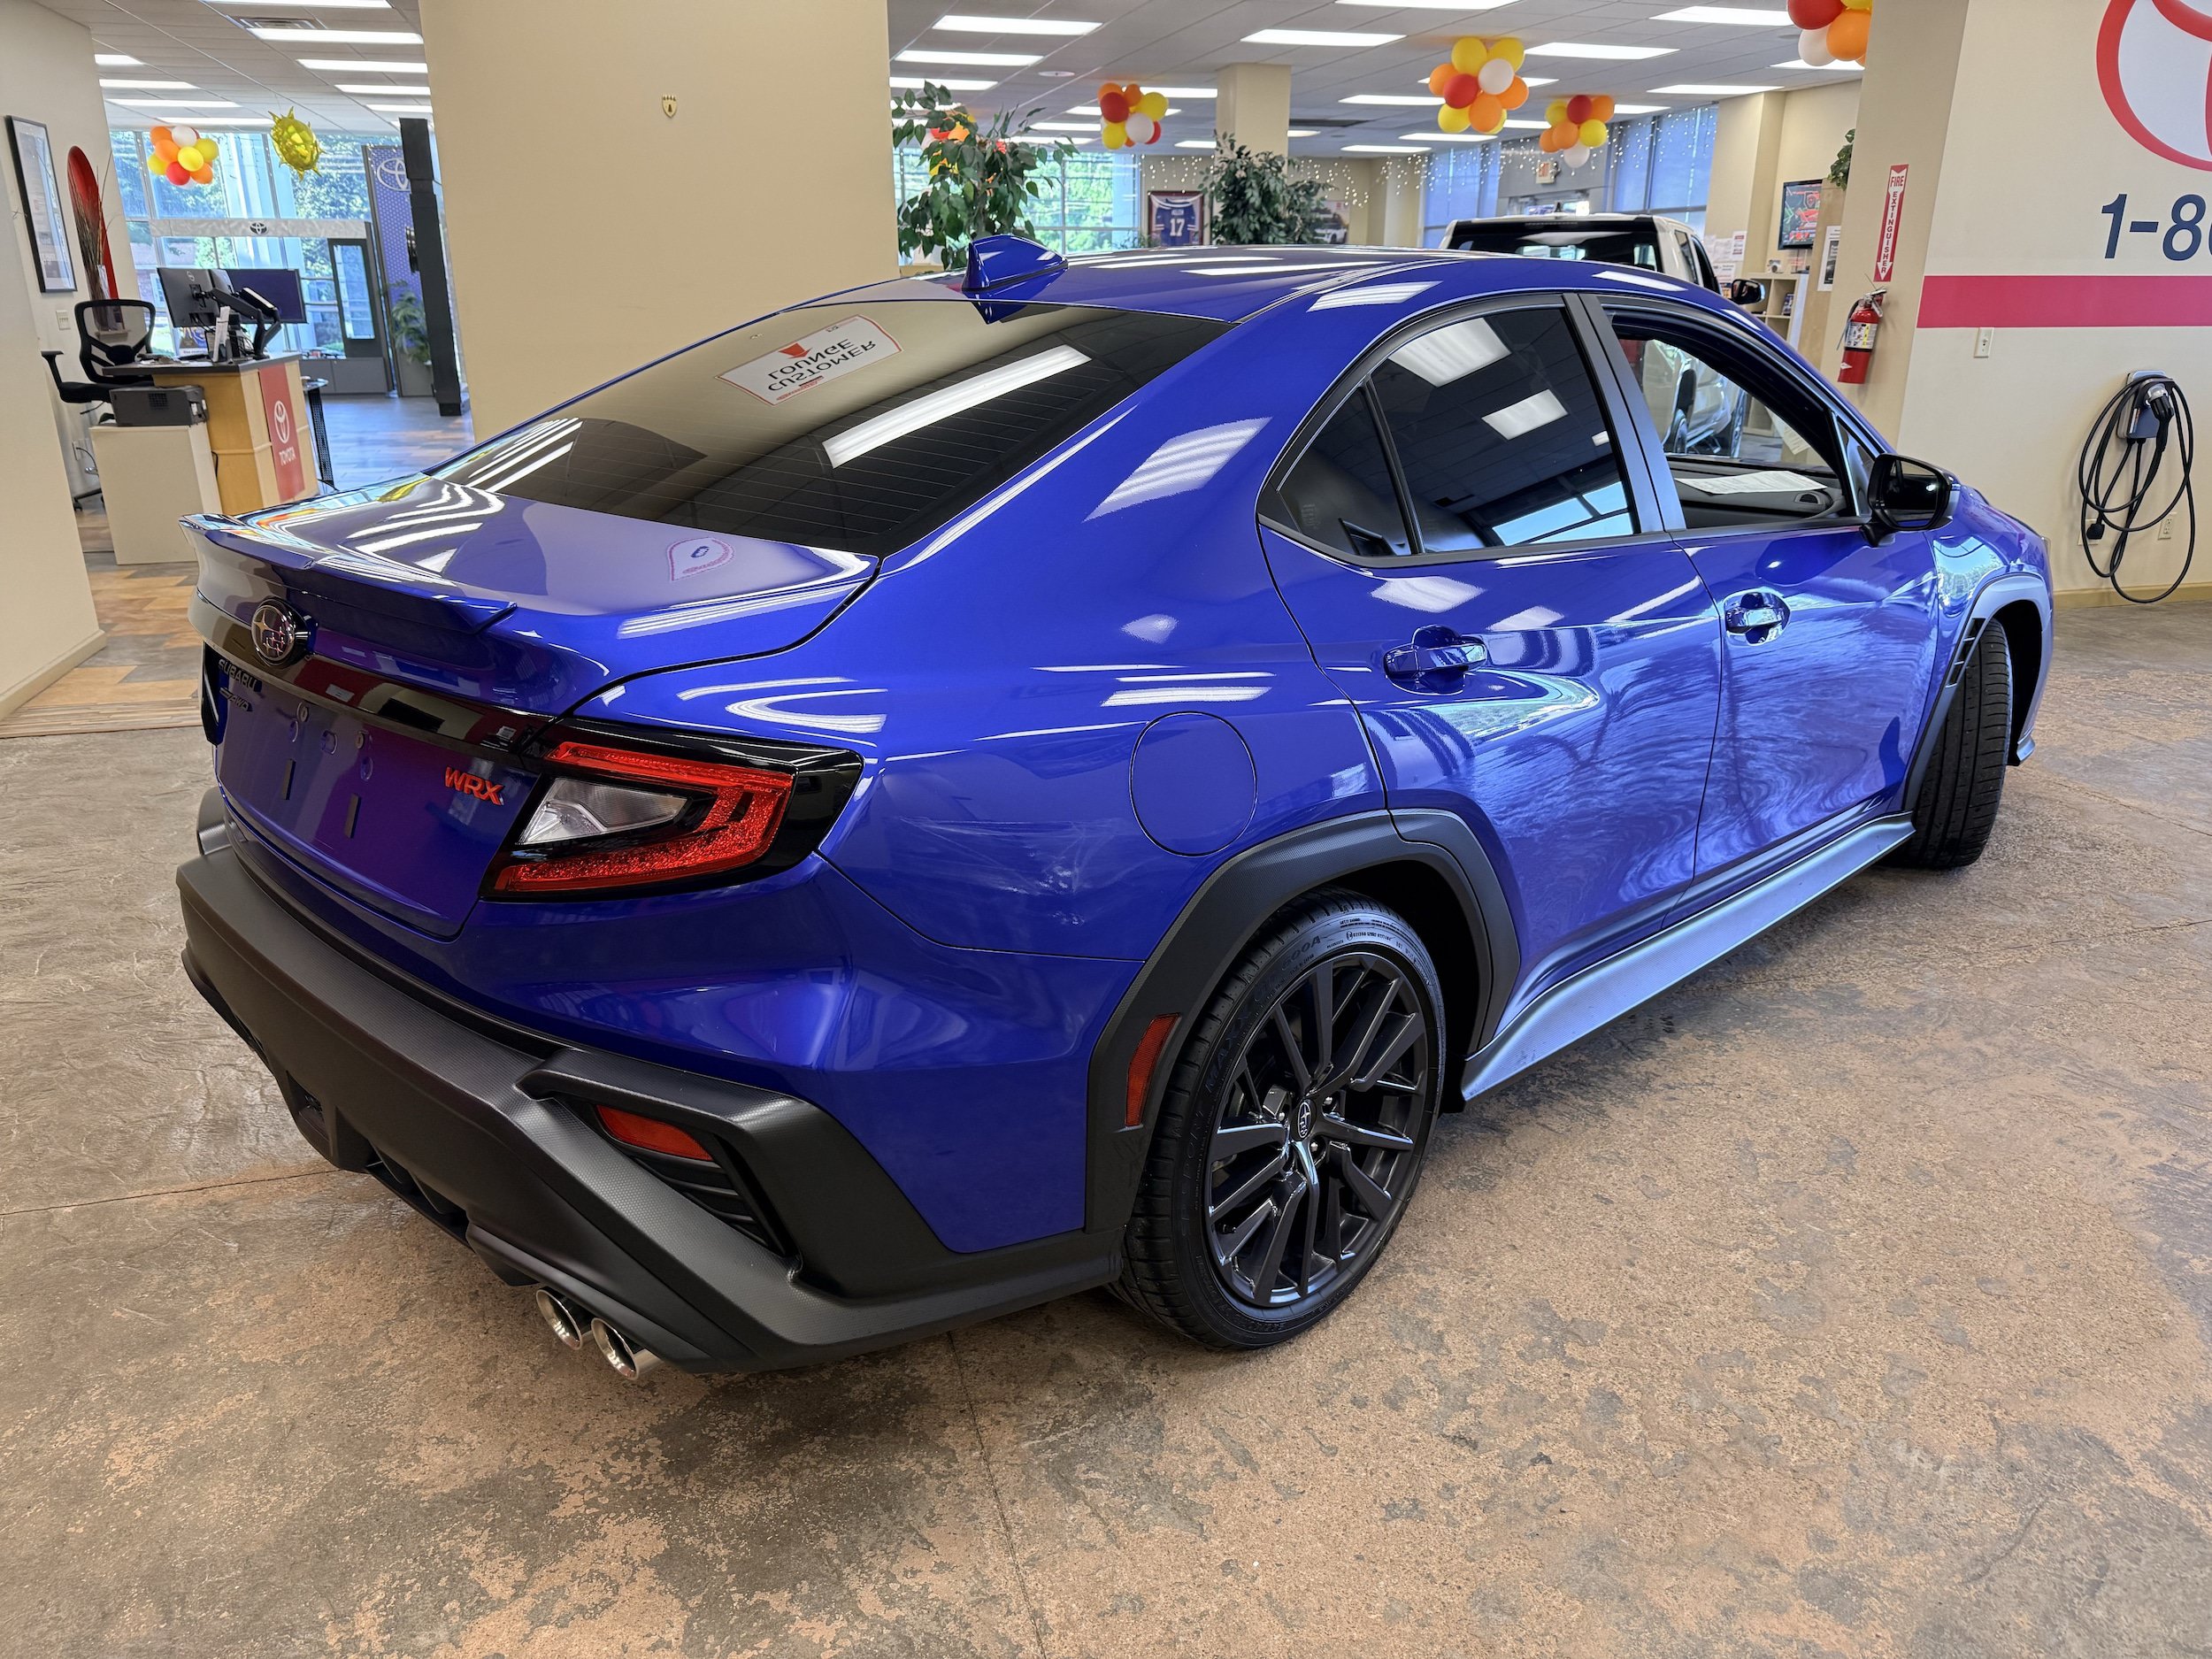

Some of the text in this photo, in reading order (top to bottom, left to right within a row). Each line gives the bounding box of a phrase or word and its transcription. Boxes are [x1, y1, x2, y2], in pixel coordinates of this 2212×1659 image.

[1890, 175, 1905, 187] FIRE
[1170, 218, 1185, 236] 17
[1880, 191, 1897, 273] EXTINGUISHER
[2101, 193, 2212, 261] 1-8
[218, 658, 257, 689] SUBARU
[445, 766, 504, 806] WRX
